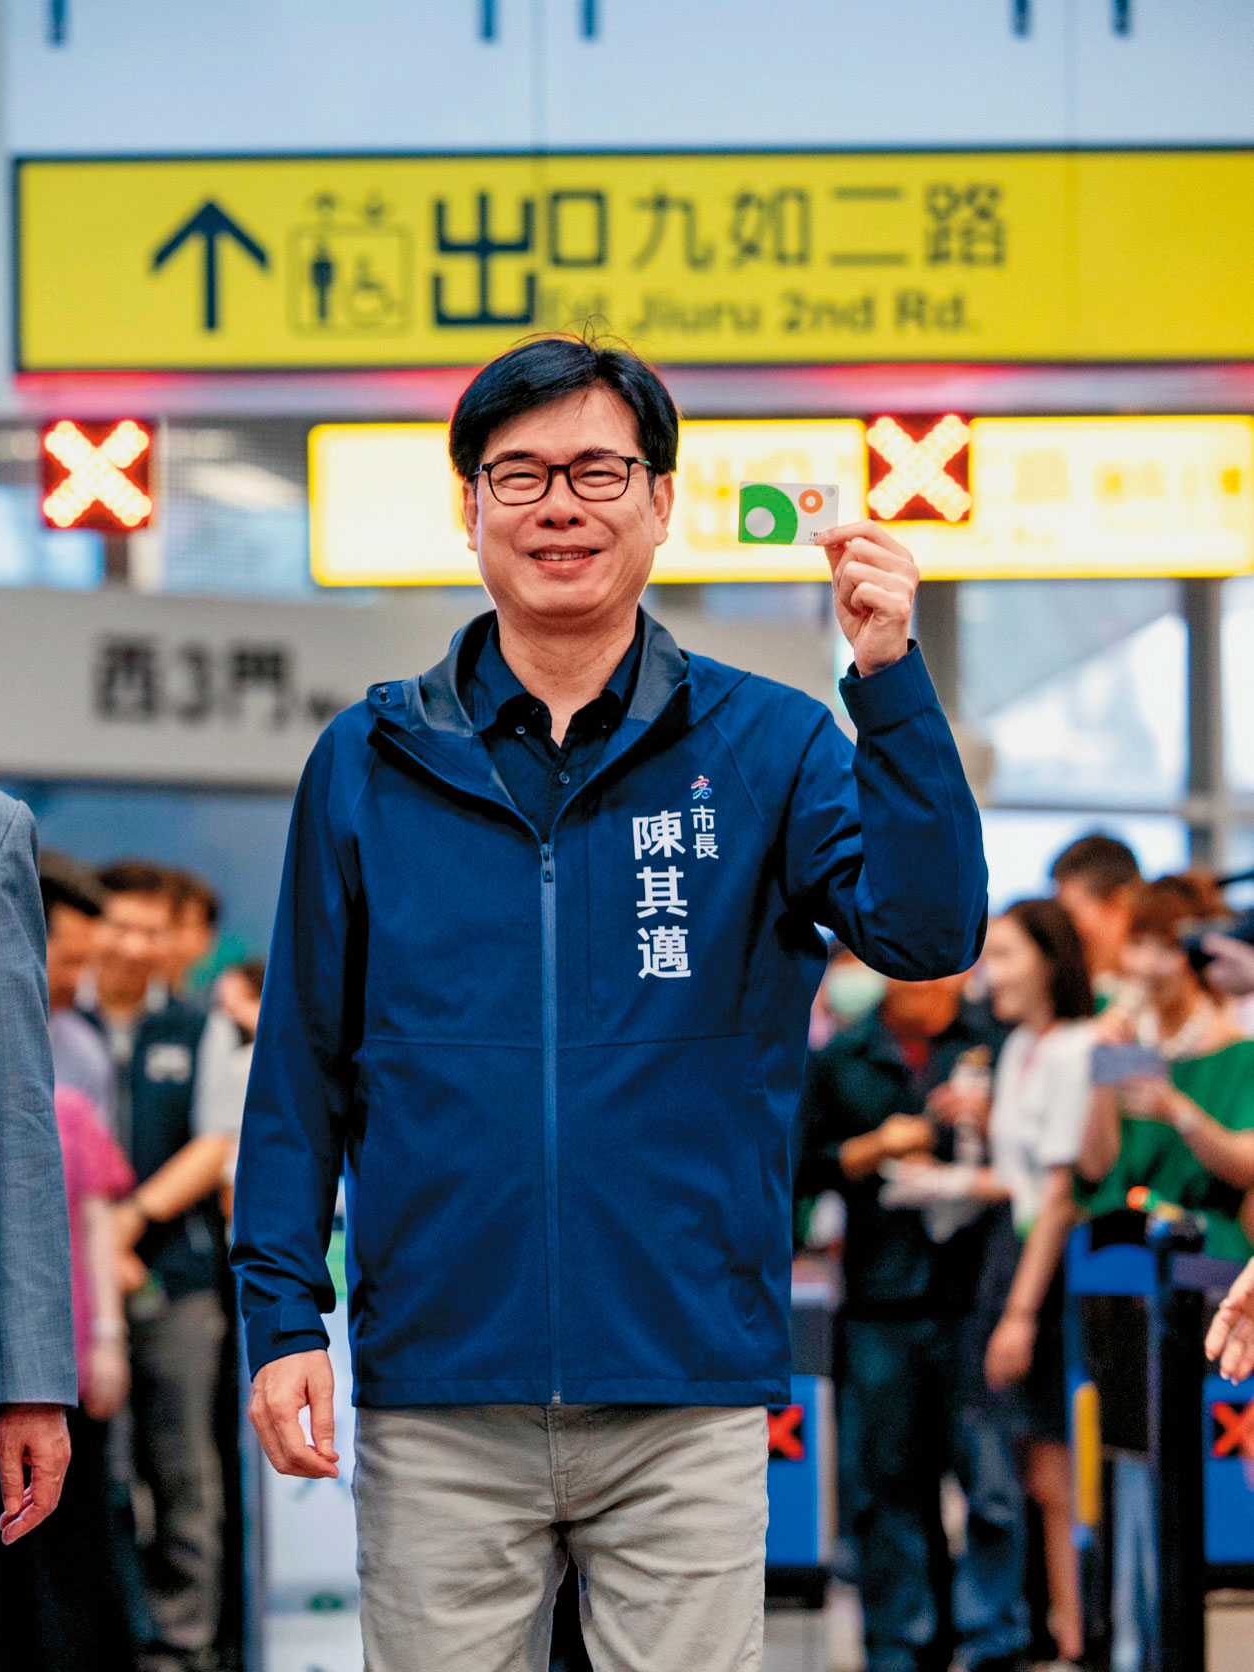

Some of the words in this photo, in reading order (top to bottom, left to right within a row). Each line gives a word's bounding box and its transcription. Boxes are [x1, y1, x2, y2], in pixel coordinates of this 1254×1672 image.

[433, 182, 1006, 326] 出口九如二路
[782, 291, 876, 334] 2nd
[690, 805, 720, 859] 市長
[632, 810, 692, 979] 陳其邁
